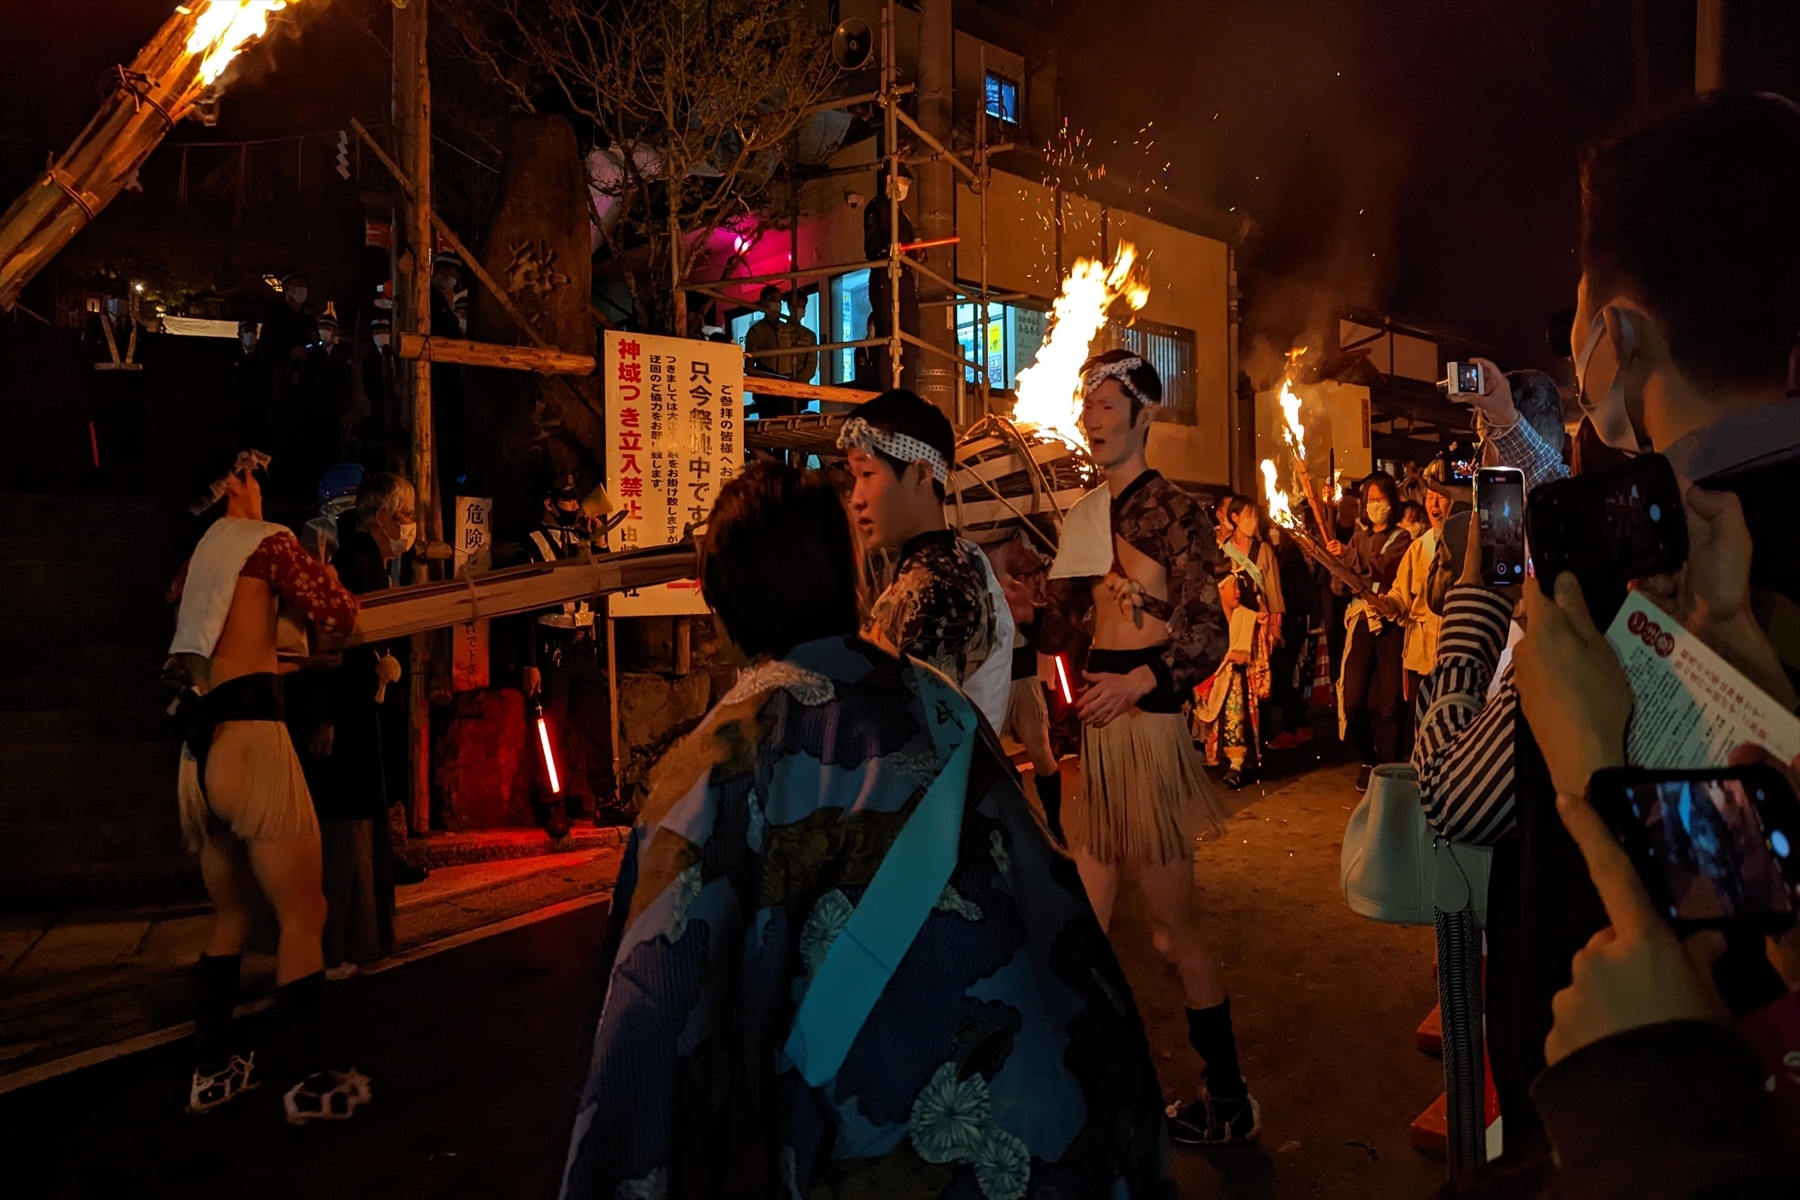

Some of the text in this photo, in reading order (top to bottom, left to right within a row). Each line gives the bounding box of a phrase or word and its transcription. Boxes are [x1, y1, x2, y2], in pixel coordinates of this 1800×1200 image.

[618, 338, 643, 521] 神域つき立入禁止
[465, 502, 484, 549] 危険
